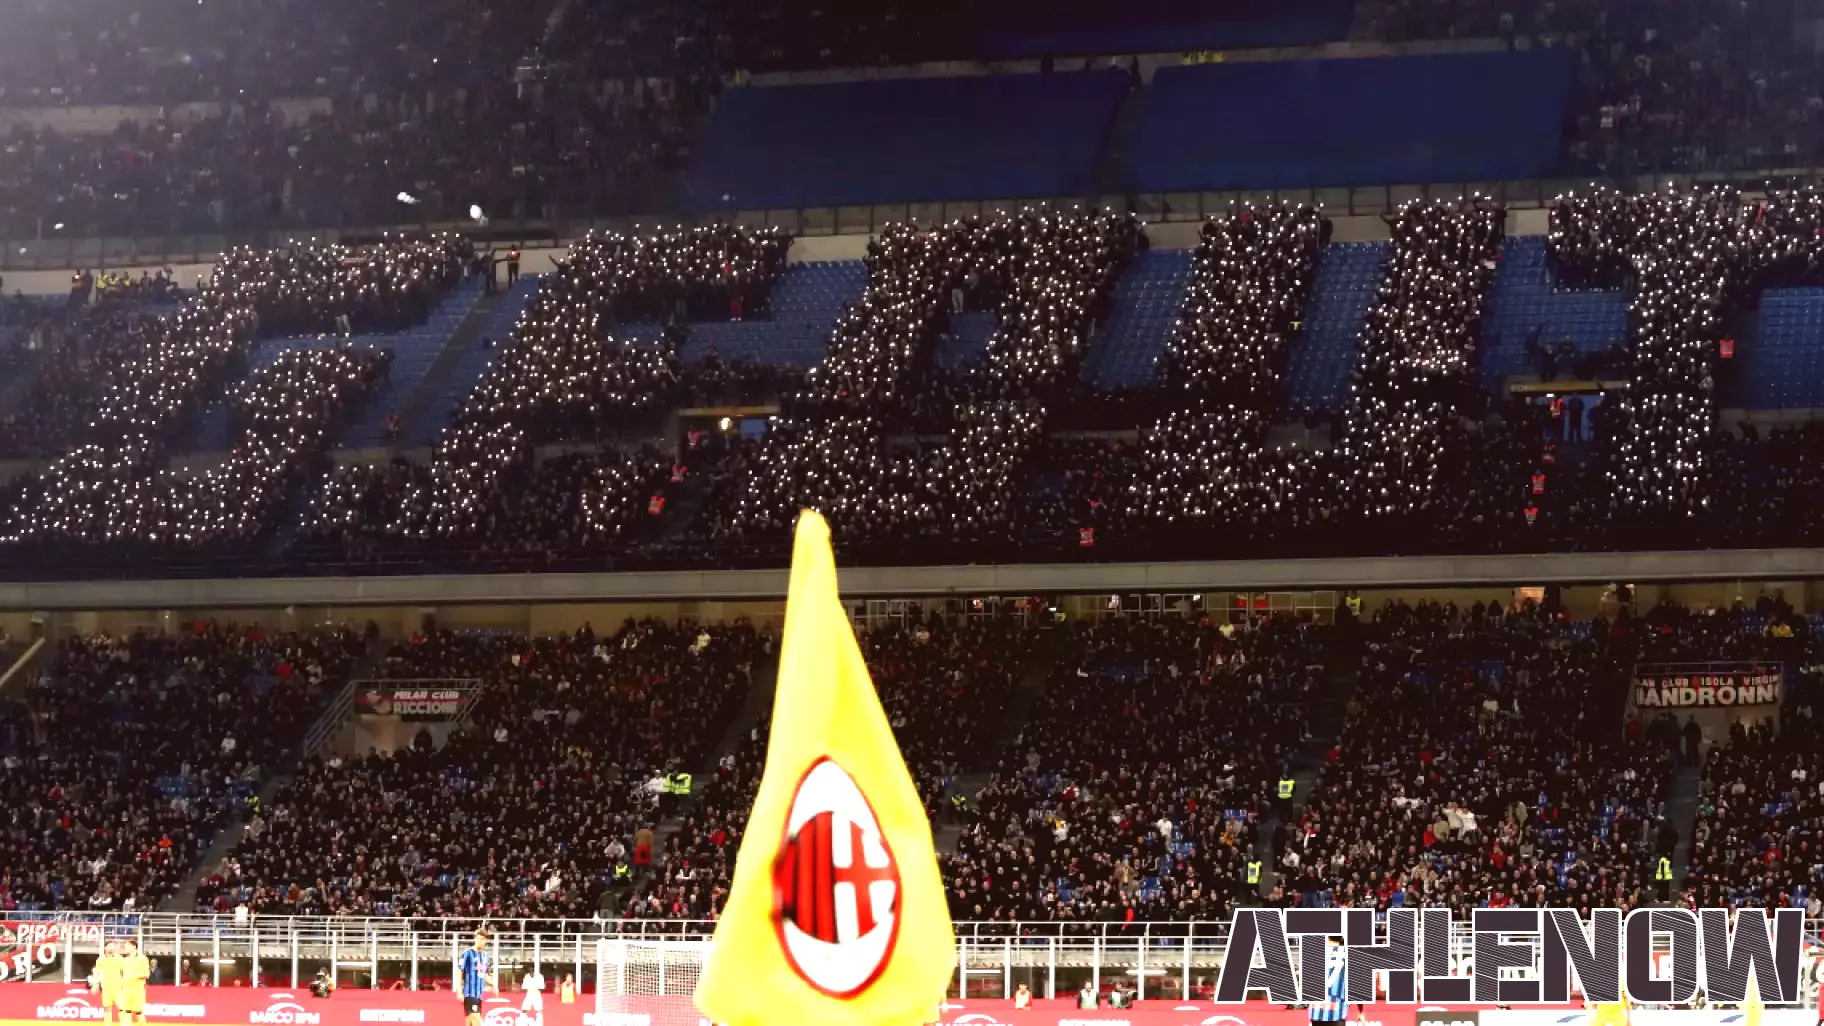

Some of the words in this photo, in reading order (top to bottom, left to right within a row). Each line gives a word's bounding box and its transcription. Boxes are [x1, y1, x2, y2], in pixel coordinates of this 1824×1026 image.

[1701, 676, 1734, 686] ISOLA
[393, 691, 428, 699] MILAN
[431, 691, 460, 699] CLUB
[393, 701, 458, 715] RICCIONE
